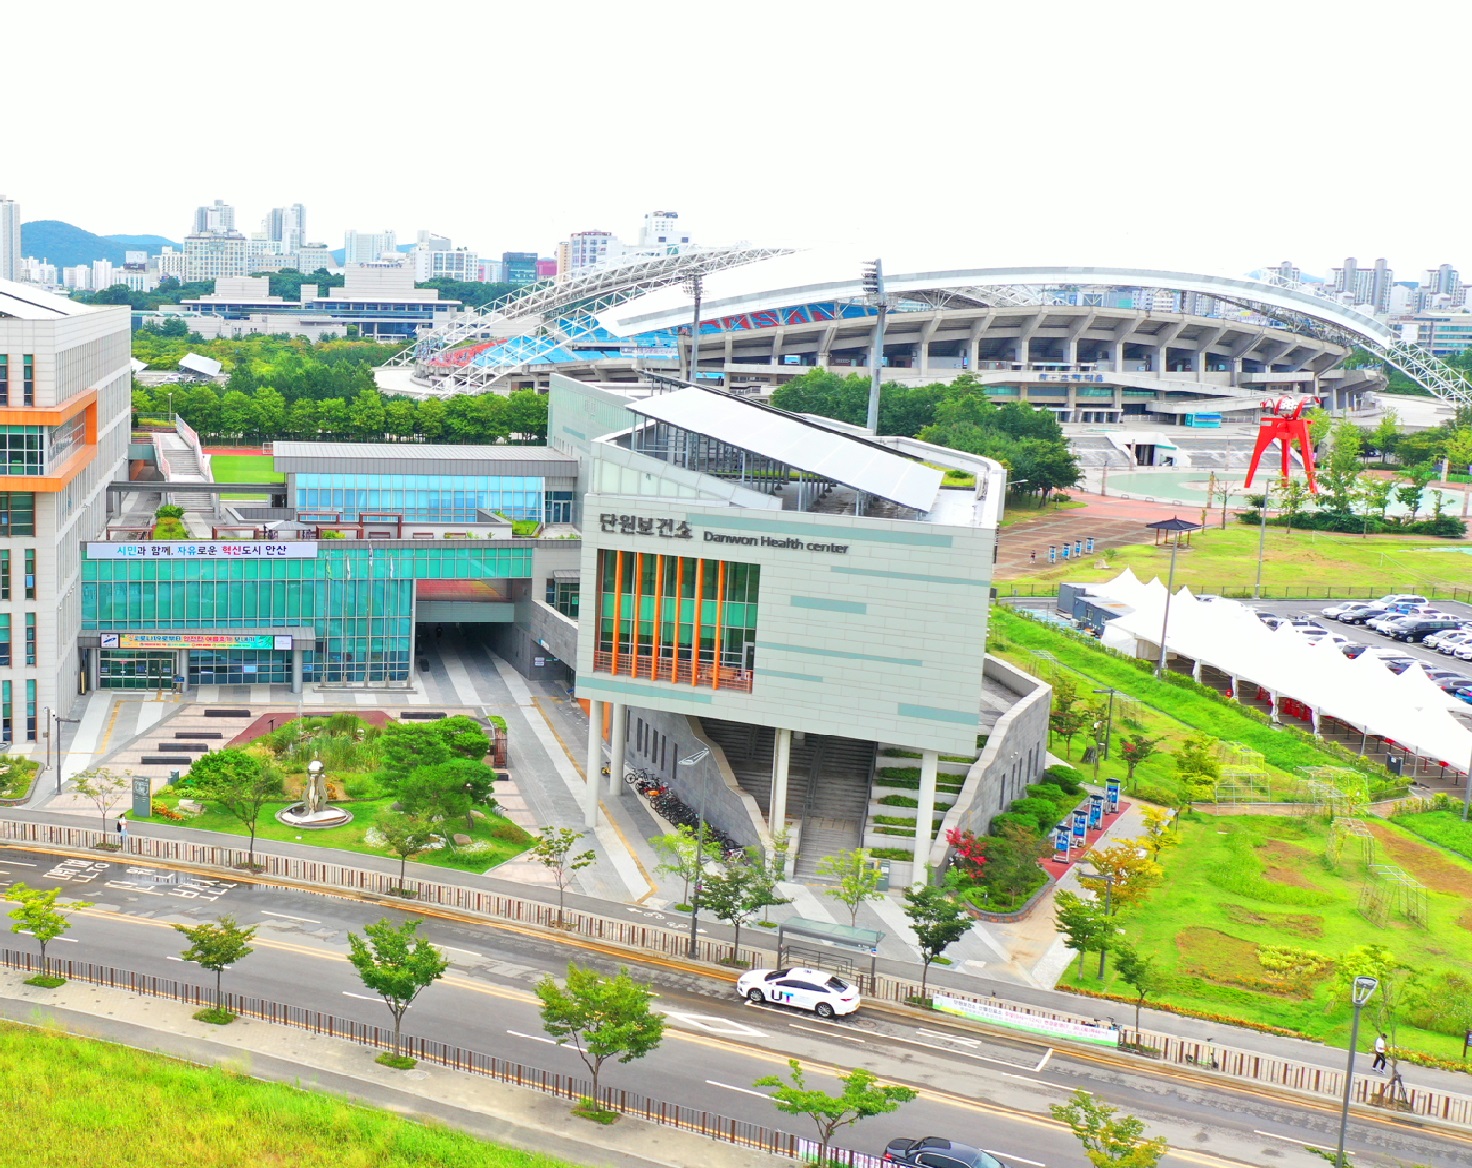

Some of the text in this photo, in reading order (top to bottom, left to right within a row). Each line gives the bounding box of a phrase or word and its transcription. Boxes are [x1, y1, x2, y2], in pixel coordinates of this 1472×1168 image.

[599, 513, 693, 539] 단원보건소
[117, 545, 146, 556] 시민과
[177, 545, 217, 556] 자유로운
[222, 545, 262, 556] 혁신도시
[265, 545, 287, 556] 안산
[703, 531, 849, 554] Danwon Health center
[771, 989, 795, 1003] UT
